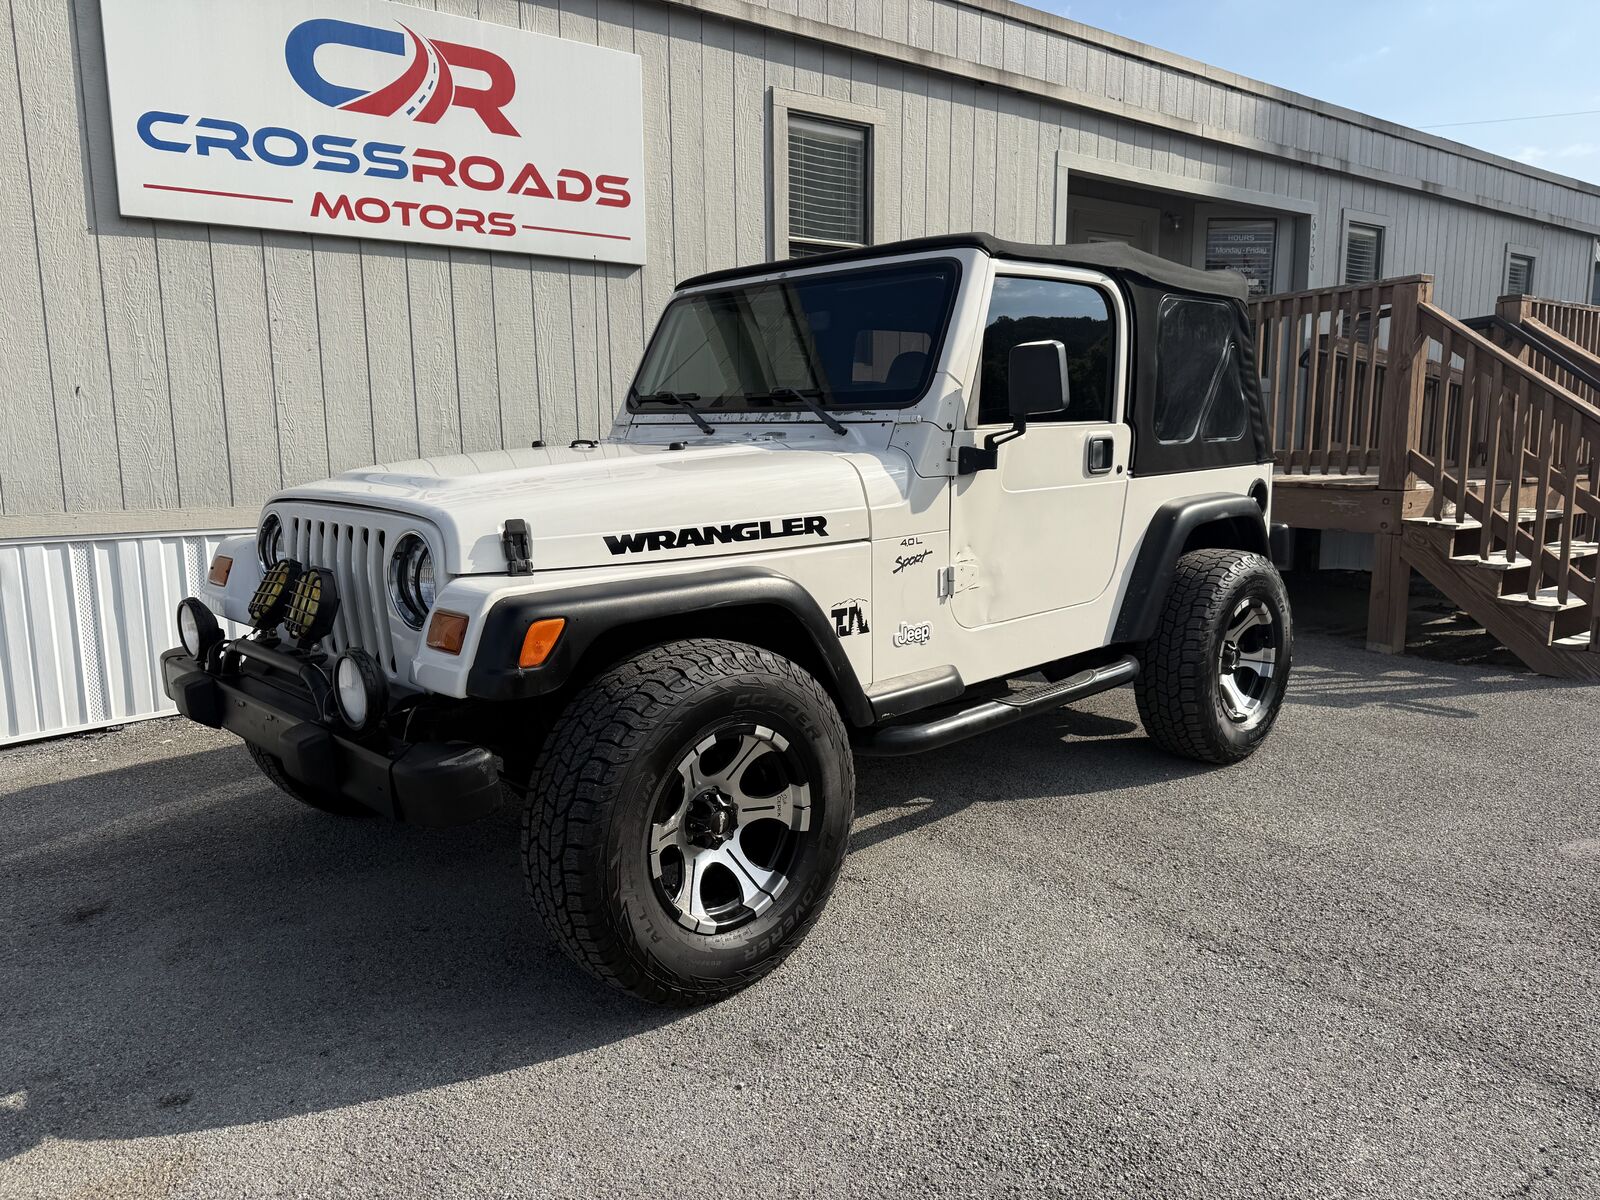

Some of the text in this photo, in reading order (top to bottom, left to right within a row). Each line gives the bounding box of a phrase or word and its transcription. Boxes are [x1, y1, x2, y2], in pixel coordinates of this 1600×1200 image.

[285, 19, 522, 137] CR
[136, 110, 631, 208] CROSSROADS
[310, 191, 517, 236] MOTORS
[1225, 265, 1255, 273] Sturday
[602, 515, 829, 556] WRANGLER
[896, 623, 932, 646] Jeep
